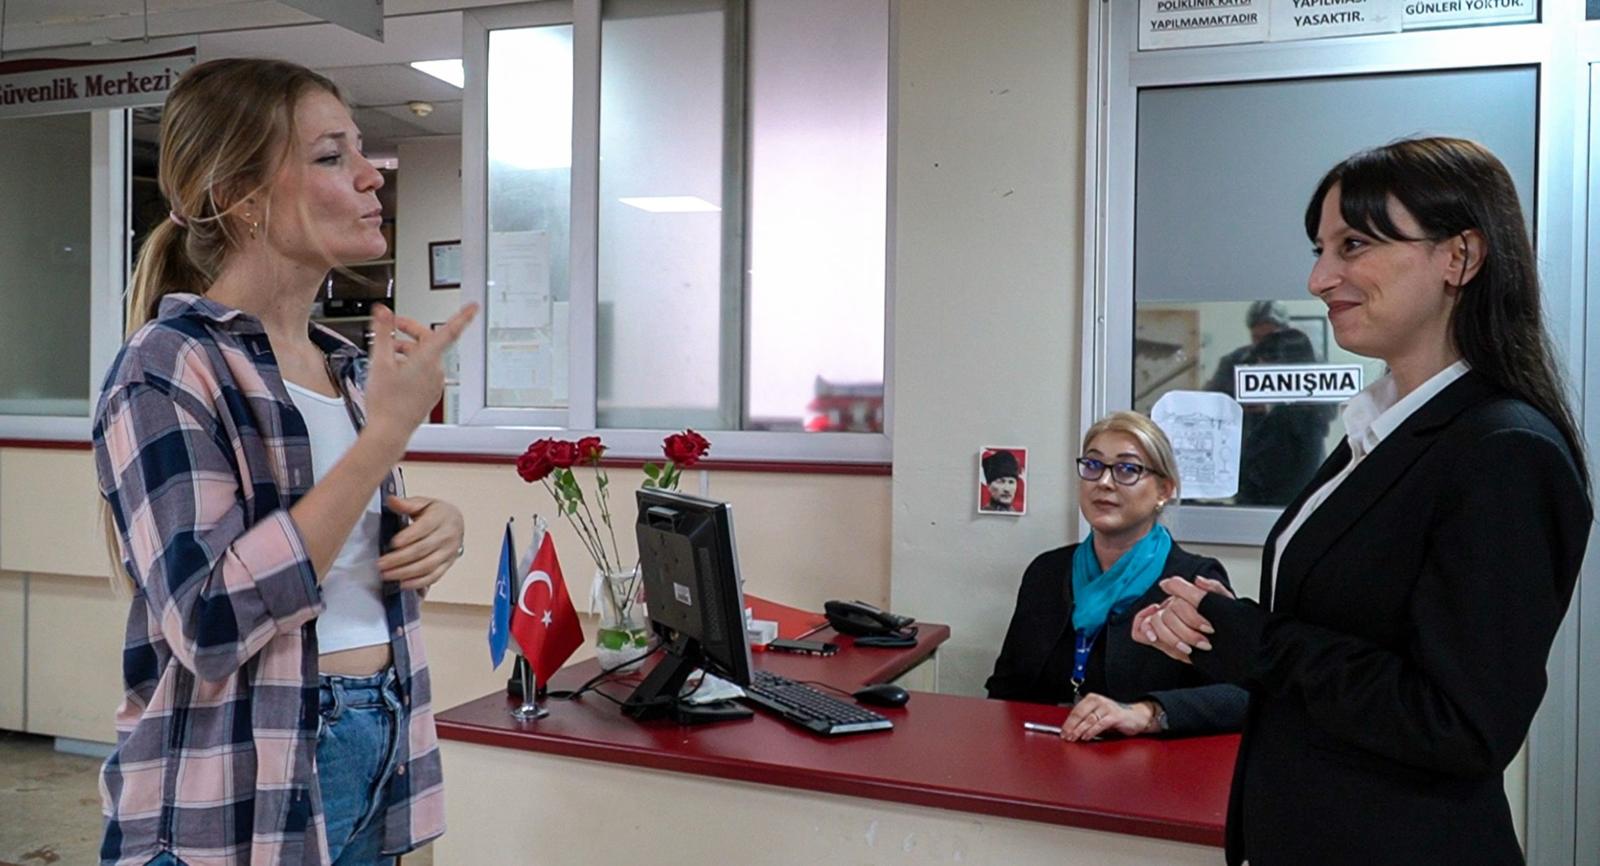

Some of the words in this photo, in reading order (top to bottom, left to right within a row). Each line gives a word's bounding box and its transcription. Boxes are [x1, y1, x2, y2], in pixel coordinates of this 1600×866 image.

[1150, 13, 1258, 29] YAPILMAMAKTADIR
[1293, 11, 1364, 27] YASAKTIR.
[0, 77, 78, 105] üvenlik
[85, 68, 171, 97] Merkezi
[1244, 372, 1356, 397] DANIŞMA
